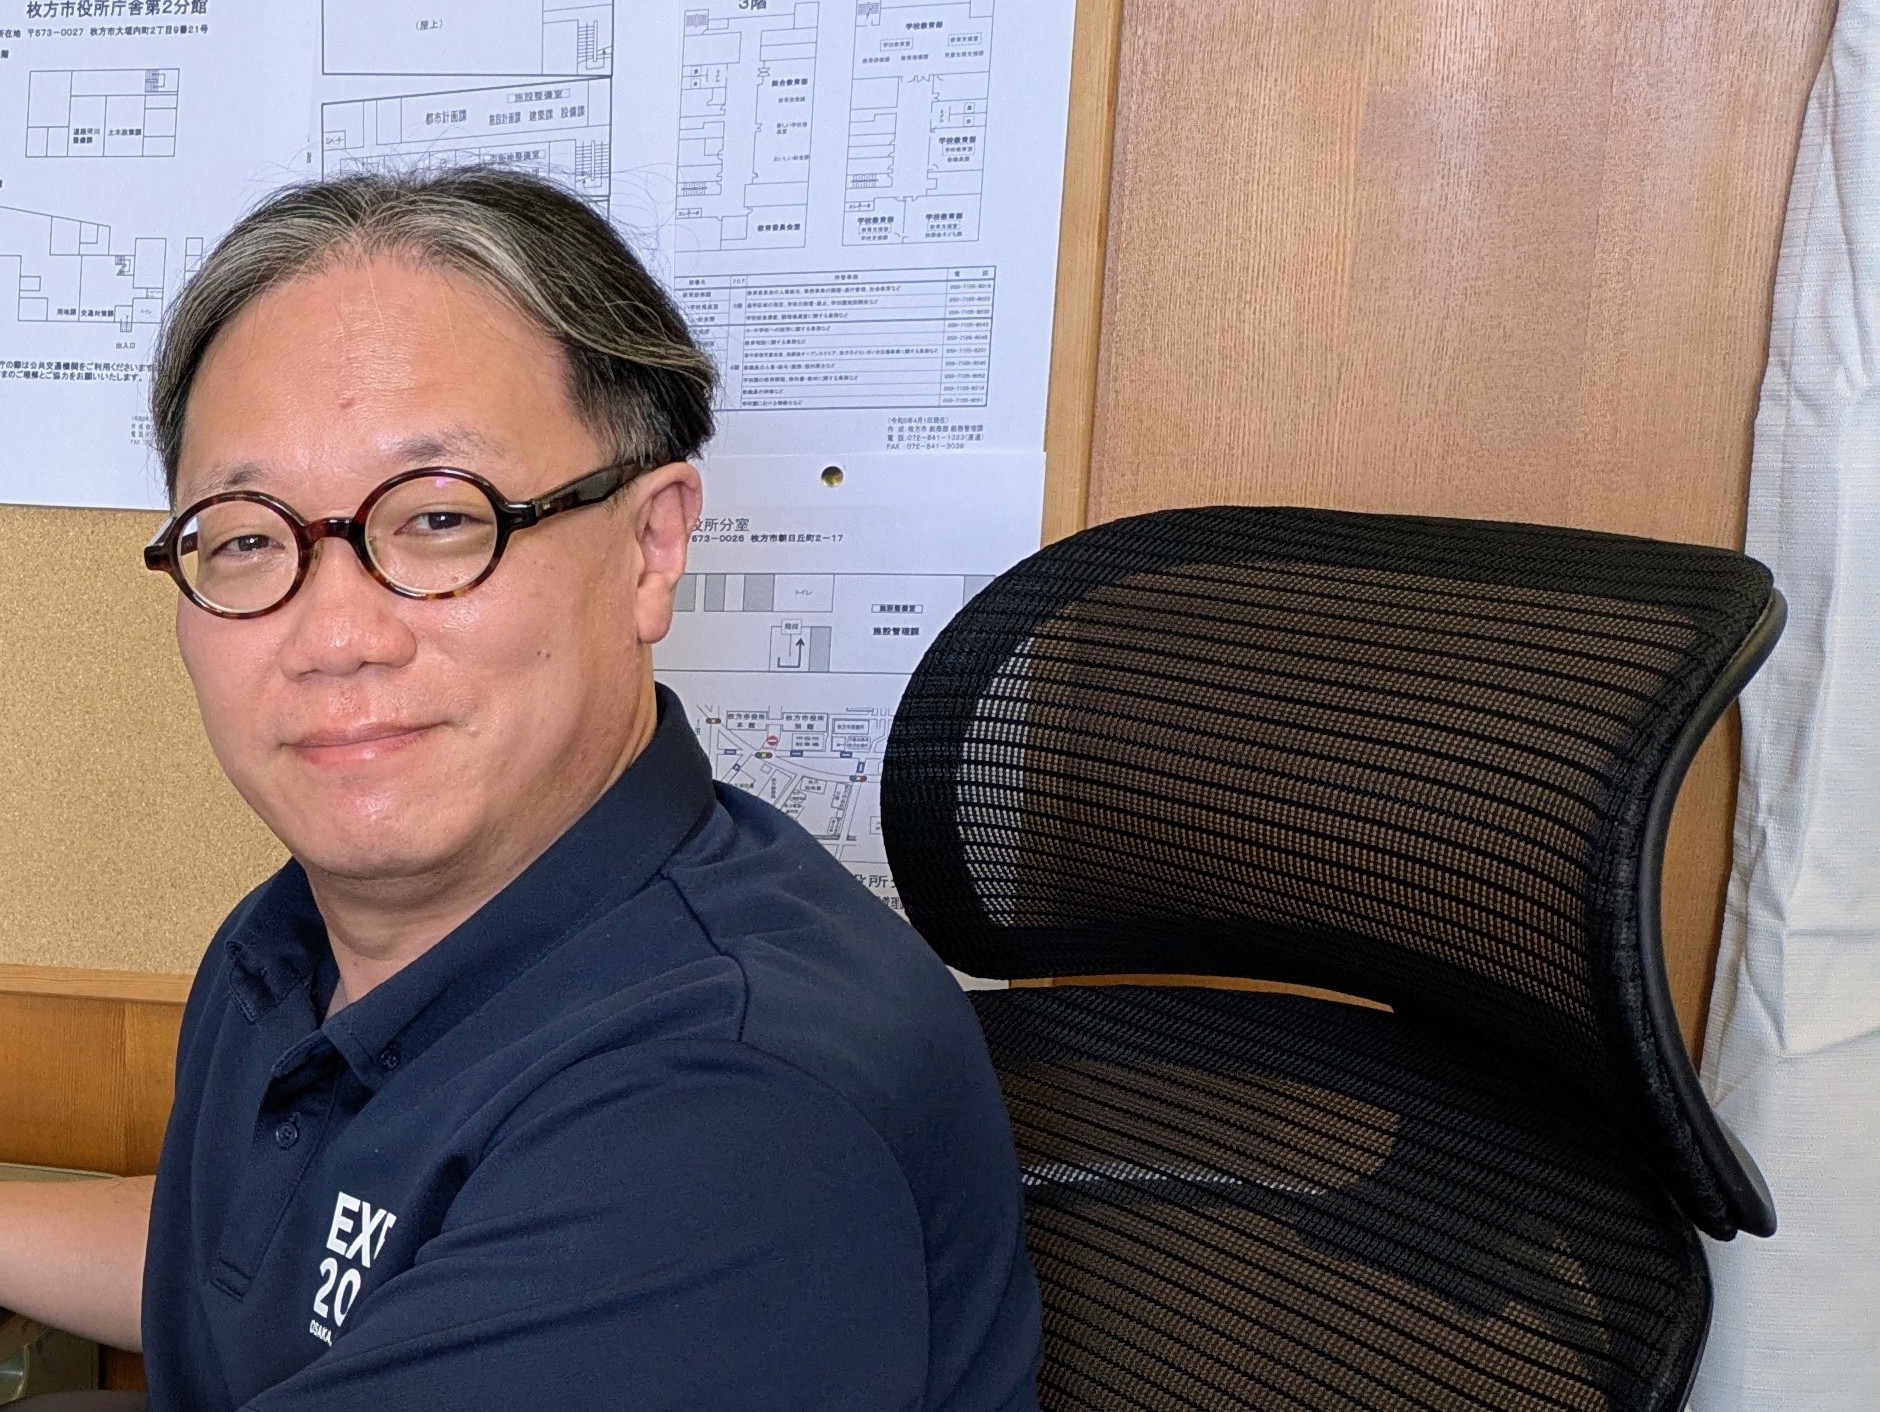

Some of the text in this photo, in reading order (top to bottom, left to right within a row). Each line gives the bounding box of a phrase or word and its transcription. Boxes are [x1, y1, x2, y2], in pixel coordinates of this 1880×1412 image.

[27, 0, 207, 18] 枚方市役所庁舎第2分館
[425, 109, 467, 125] 都市計画課
[529, 109, 554, 122] 建築課
[561, 105, 586, 119] 設備課
